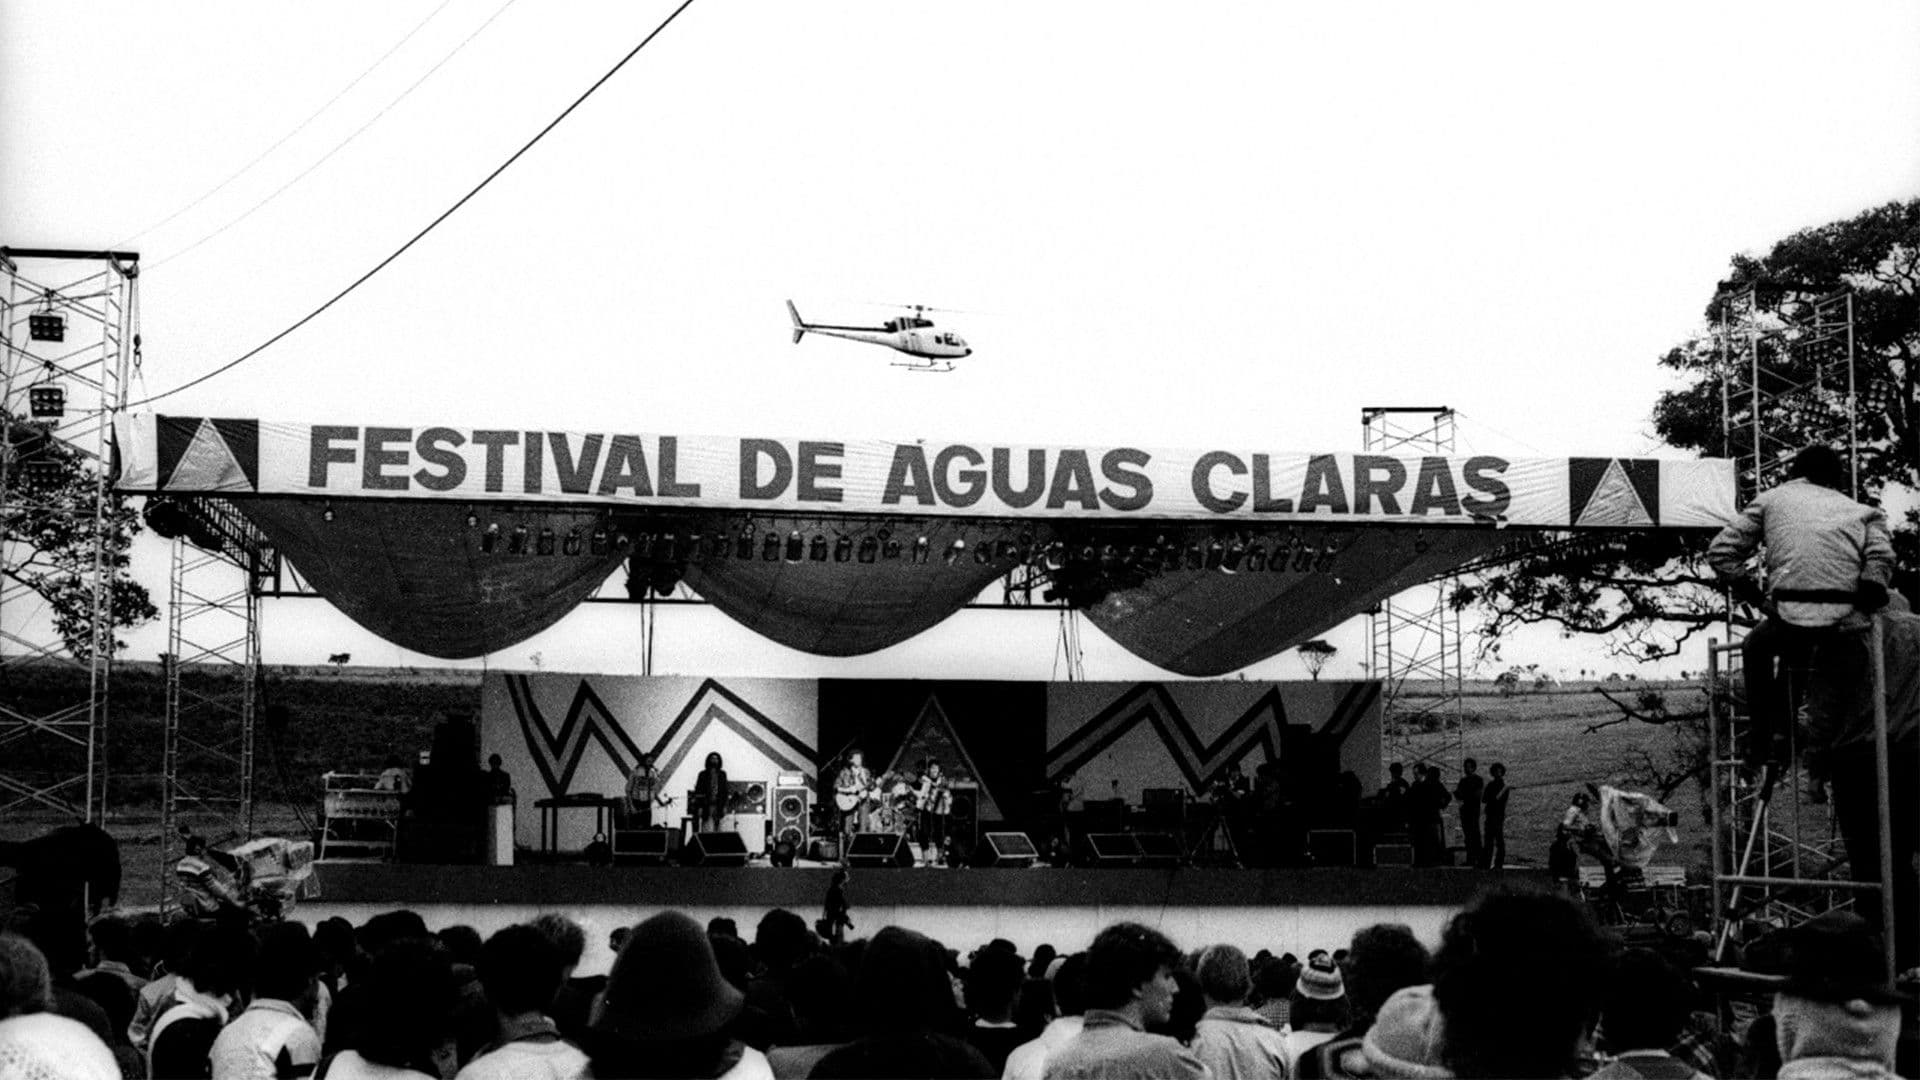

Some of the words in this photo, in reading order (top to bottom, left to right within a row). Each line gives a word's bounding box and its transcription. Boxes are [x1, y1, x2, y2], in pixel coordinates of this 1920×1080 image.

[308, 425, 701, 498] FESTIVAL
[739, 438, 844, 502] DE
[1191, 450, 1512, 518] CLARAS
